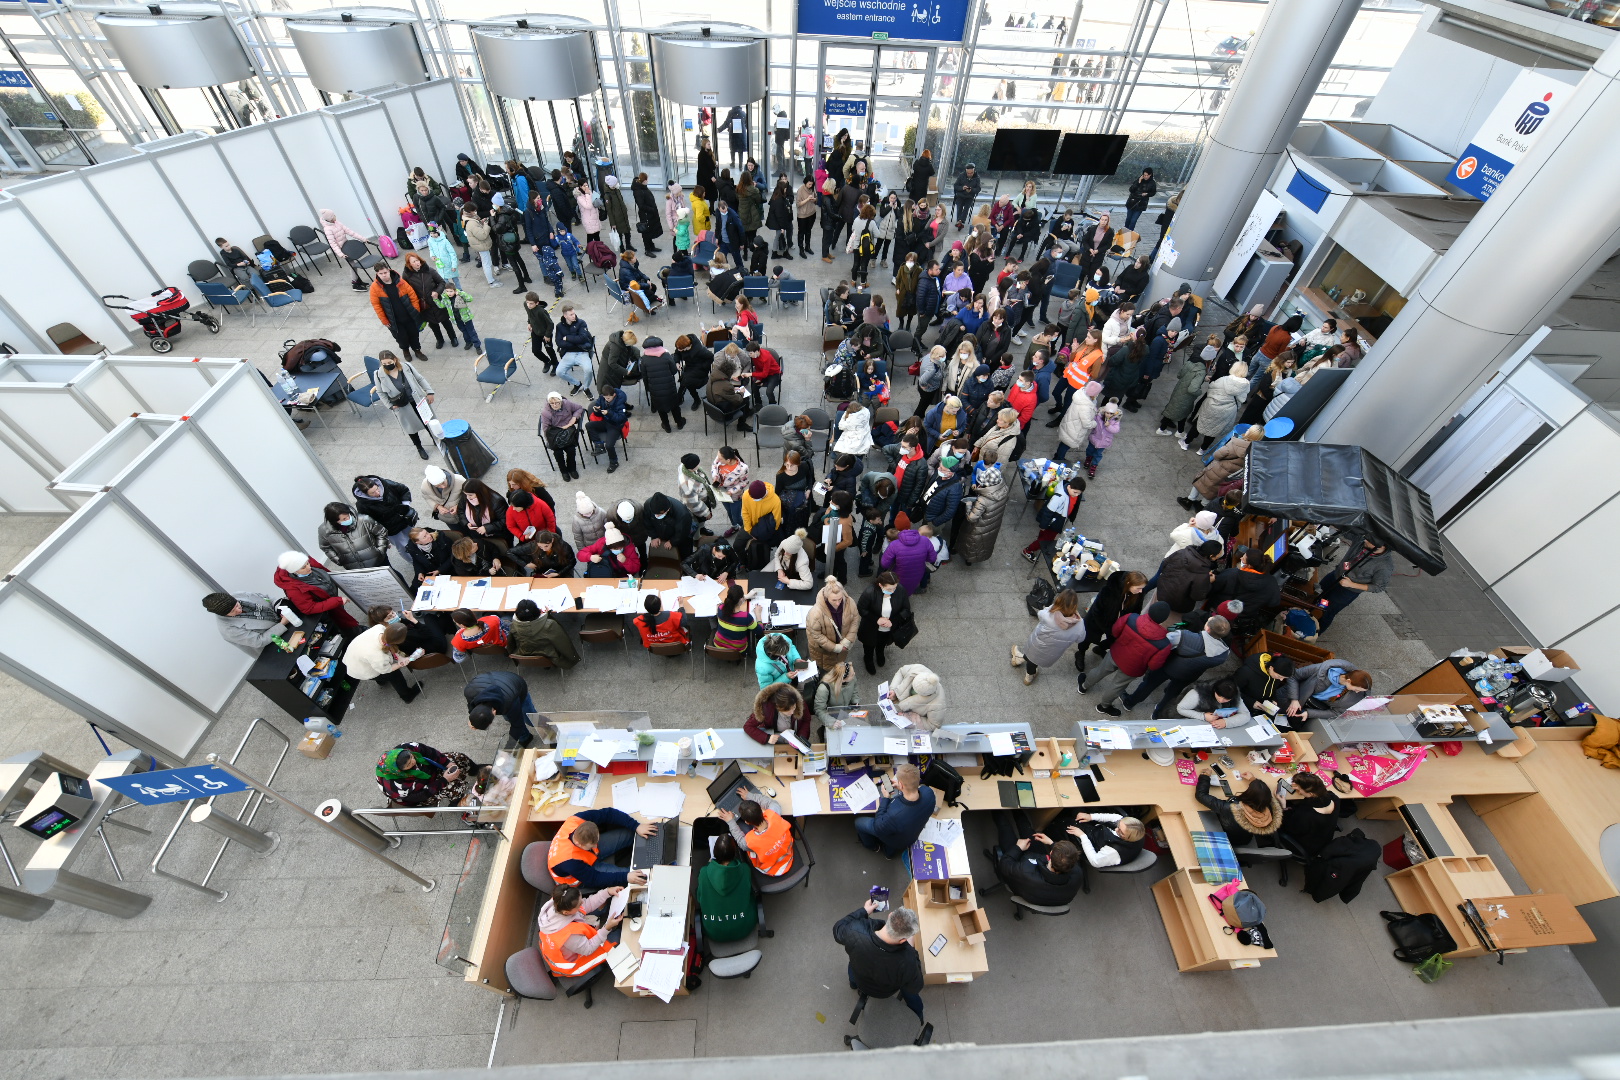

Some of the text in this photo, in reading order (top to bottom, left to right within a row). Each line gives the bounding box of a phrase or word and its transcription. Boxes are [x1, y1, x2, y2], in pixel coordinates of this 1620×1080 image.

[859, 0, 906, 11] wschodnie
[837, 12, 896, 23] eastern entrance
[1496, 134, 1512, 147] Bank
[703, 911, 745, 922] CULTUR
